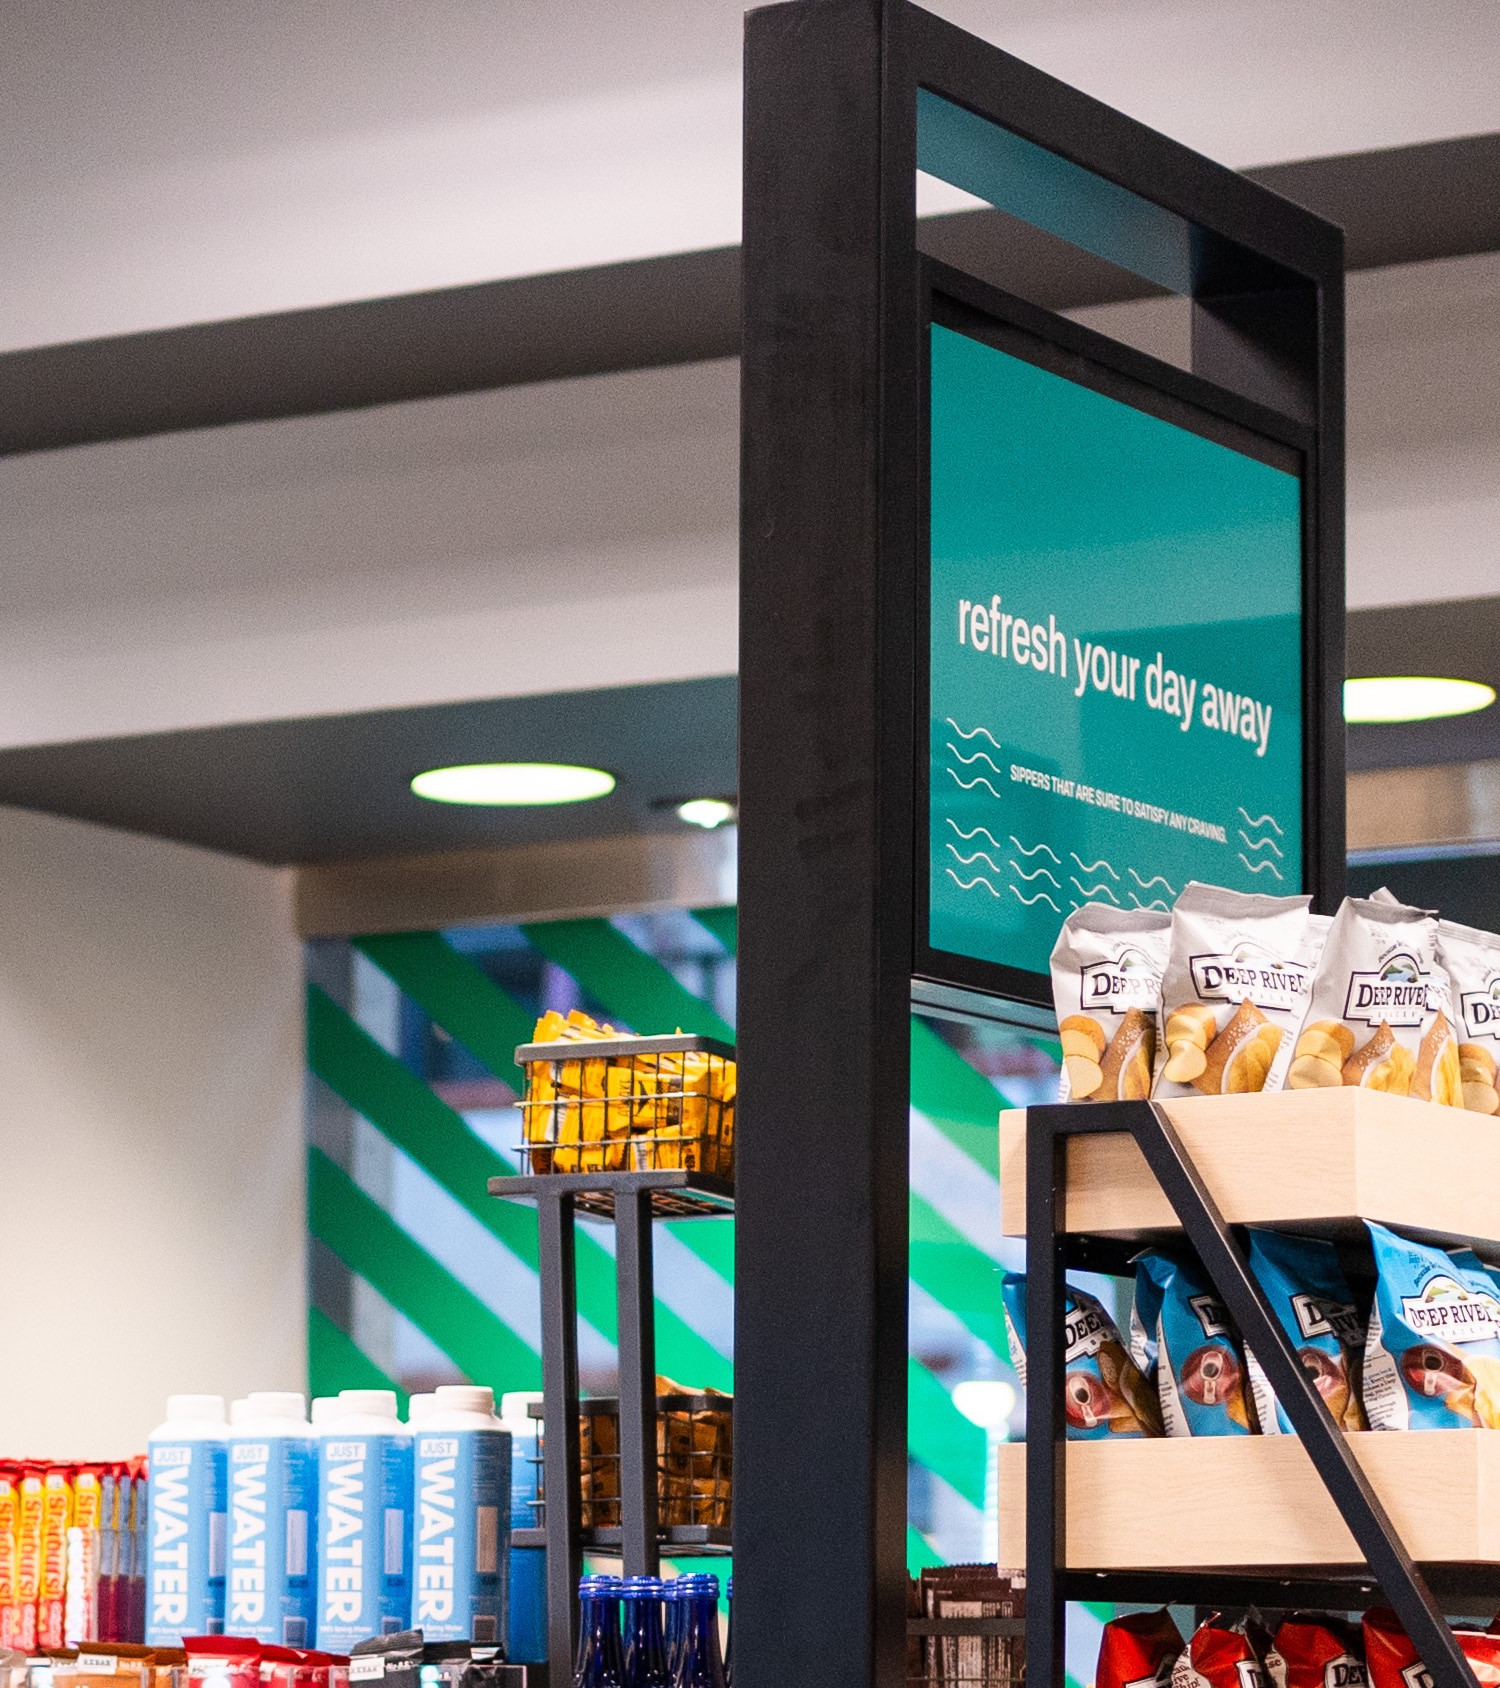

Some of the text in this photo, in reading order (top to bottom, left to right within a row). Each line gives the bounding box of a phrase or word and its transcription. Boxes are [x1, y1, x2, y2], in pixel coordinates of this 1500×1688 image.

[958, 595, 1273, 757] refresh your day away
[1010, 764, 1050, 791] SIPPERS
[1051, 776, 1075, 797] THAT
[1075, 784, 1095, 805] ARE
[1096, 789, 1120, 812] SURE
[1122, 797, 1134, 816] TO
[1134, 800, 1170, 826] SATISFY
[1169, 811, 1188, 832] ANY
[1202, 966, 1257, 990] DEEP
[1356, 983, 1391, 1009] DEEP
[157, 1450, 187, 1463] JUST
[235, 1448, 266, 1461] JUST
[330, 1445, 363, 1458] JUST
[422, 1441, 454, 1455] JUST
[154, 1465, 190, 1623] WATER
[231, 1462, 268, 1623] WATER
[325, 1461, 366, 1622] WATER
[418, 1458, 456, 1622] WATER
